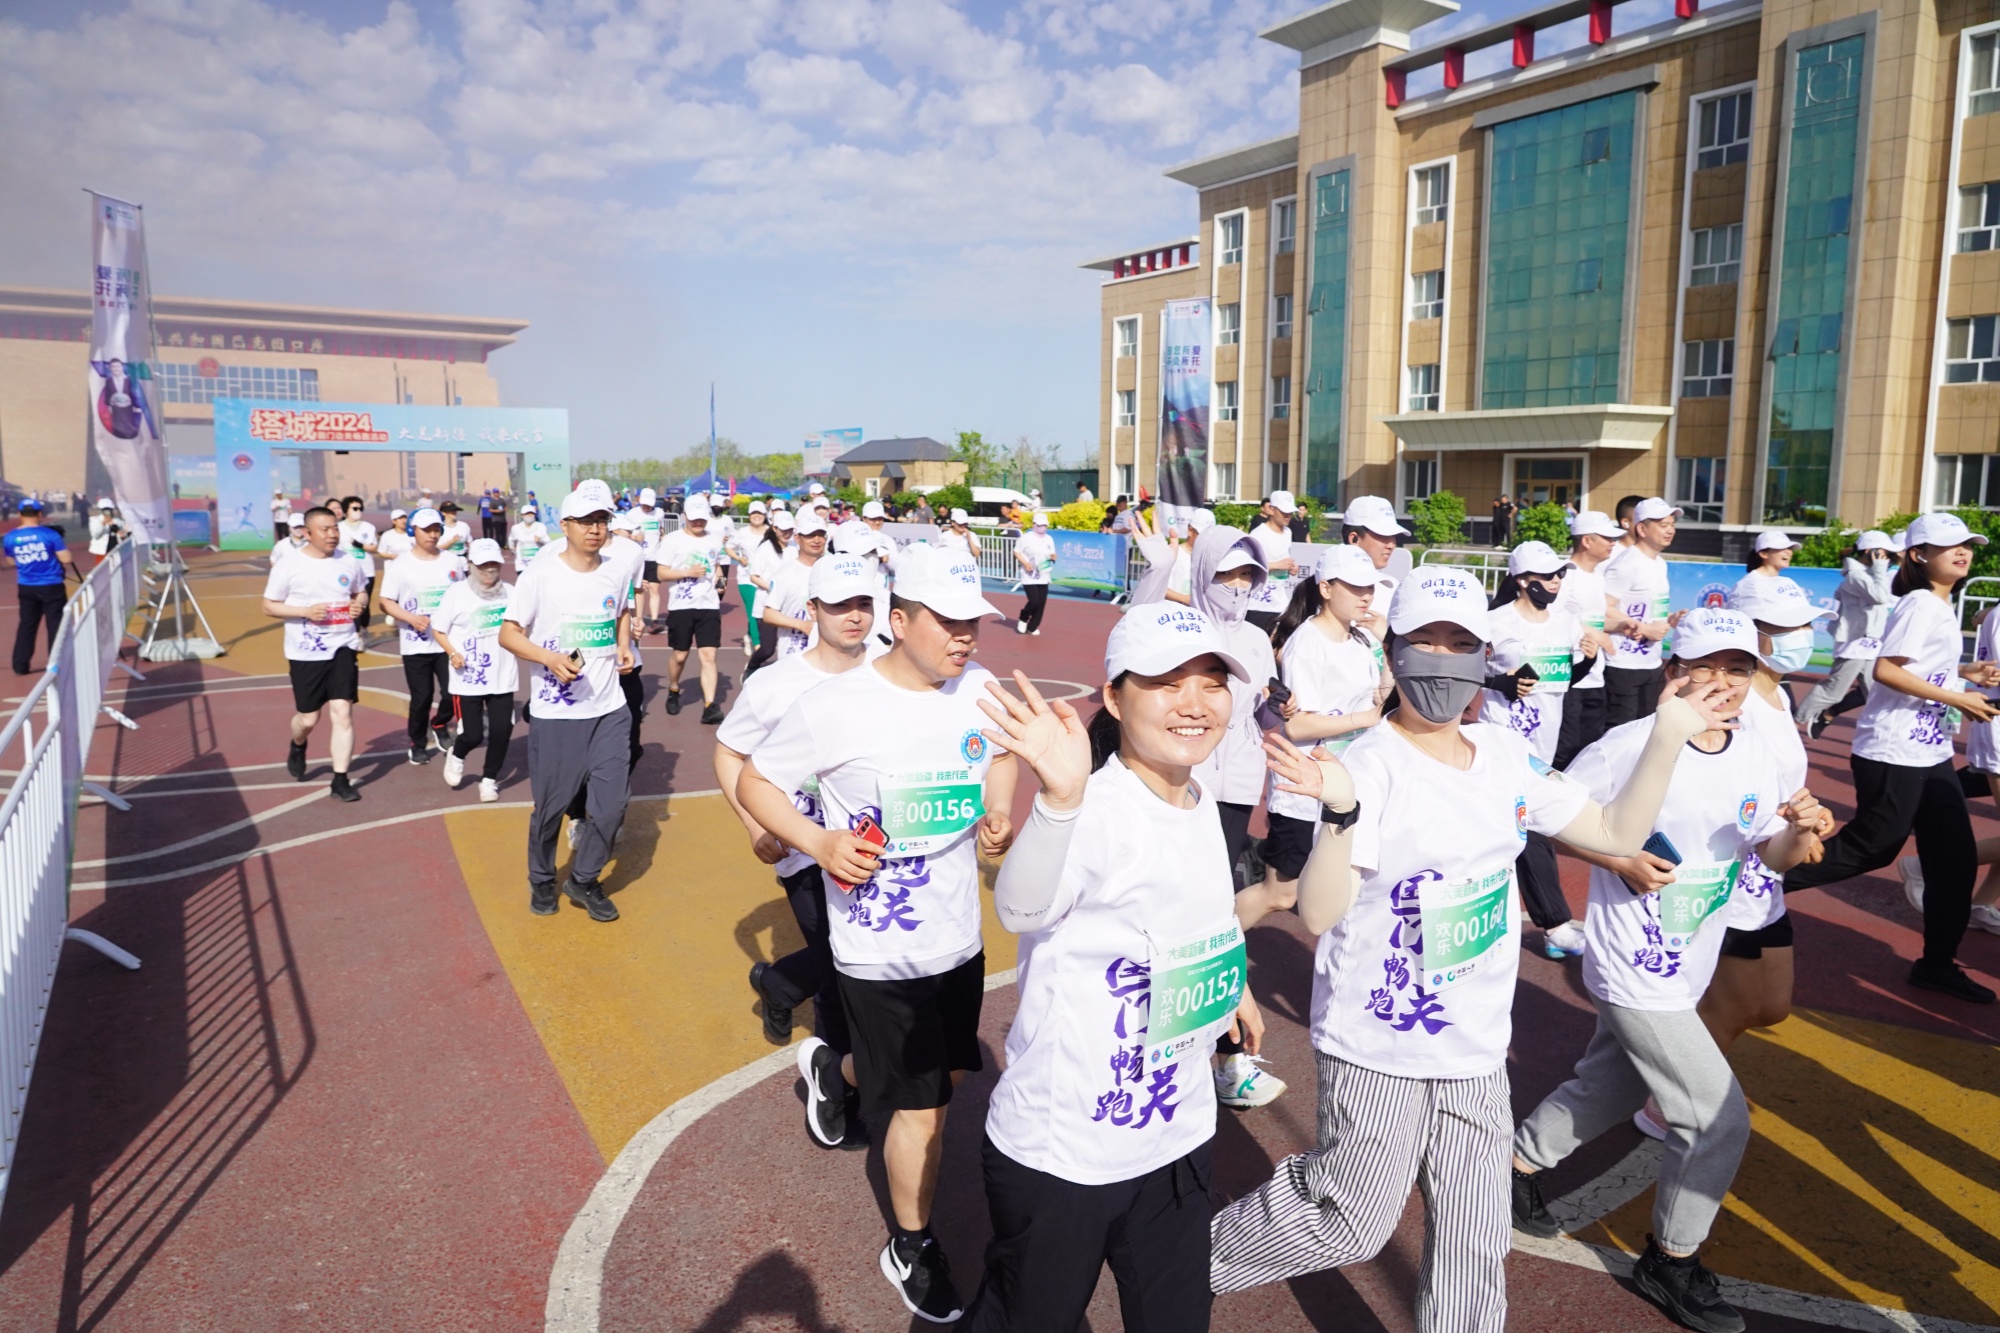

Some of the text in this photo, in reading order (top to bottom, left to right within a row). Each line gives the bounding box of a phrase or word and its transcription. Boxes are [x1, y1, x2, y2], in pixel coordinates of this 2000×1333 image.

[1421, 578, 1467, 590] 国门边关
[1433, 589, 1458, 598] 畅跑
[575, 627, 614, 641] 00050
[906, 798, 975, 824] 00156
[1453, 899, 1505, 947] 00160
[1210, 927, 1238, 950] 我来代言
[1175, 966, 1241, 1017] 00152
[1158, 987, 1176, 1028] 欢乐
